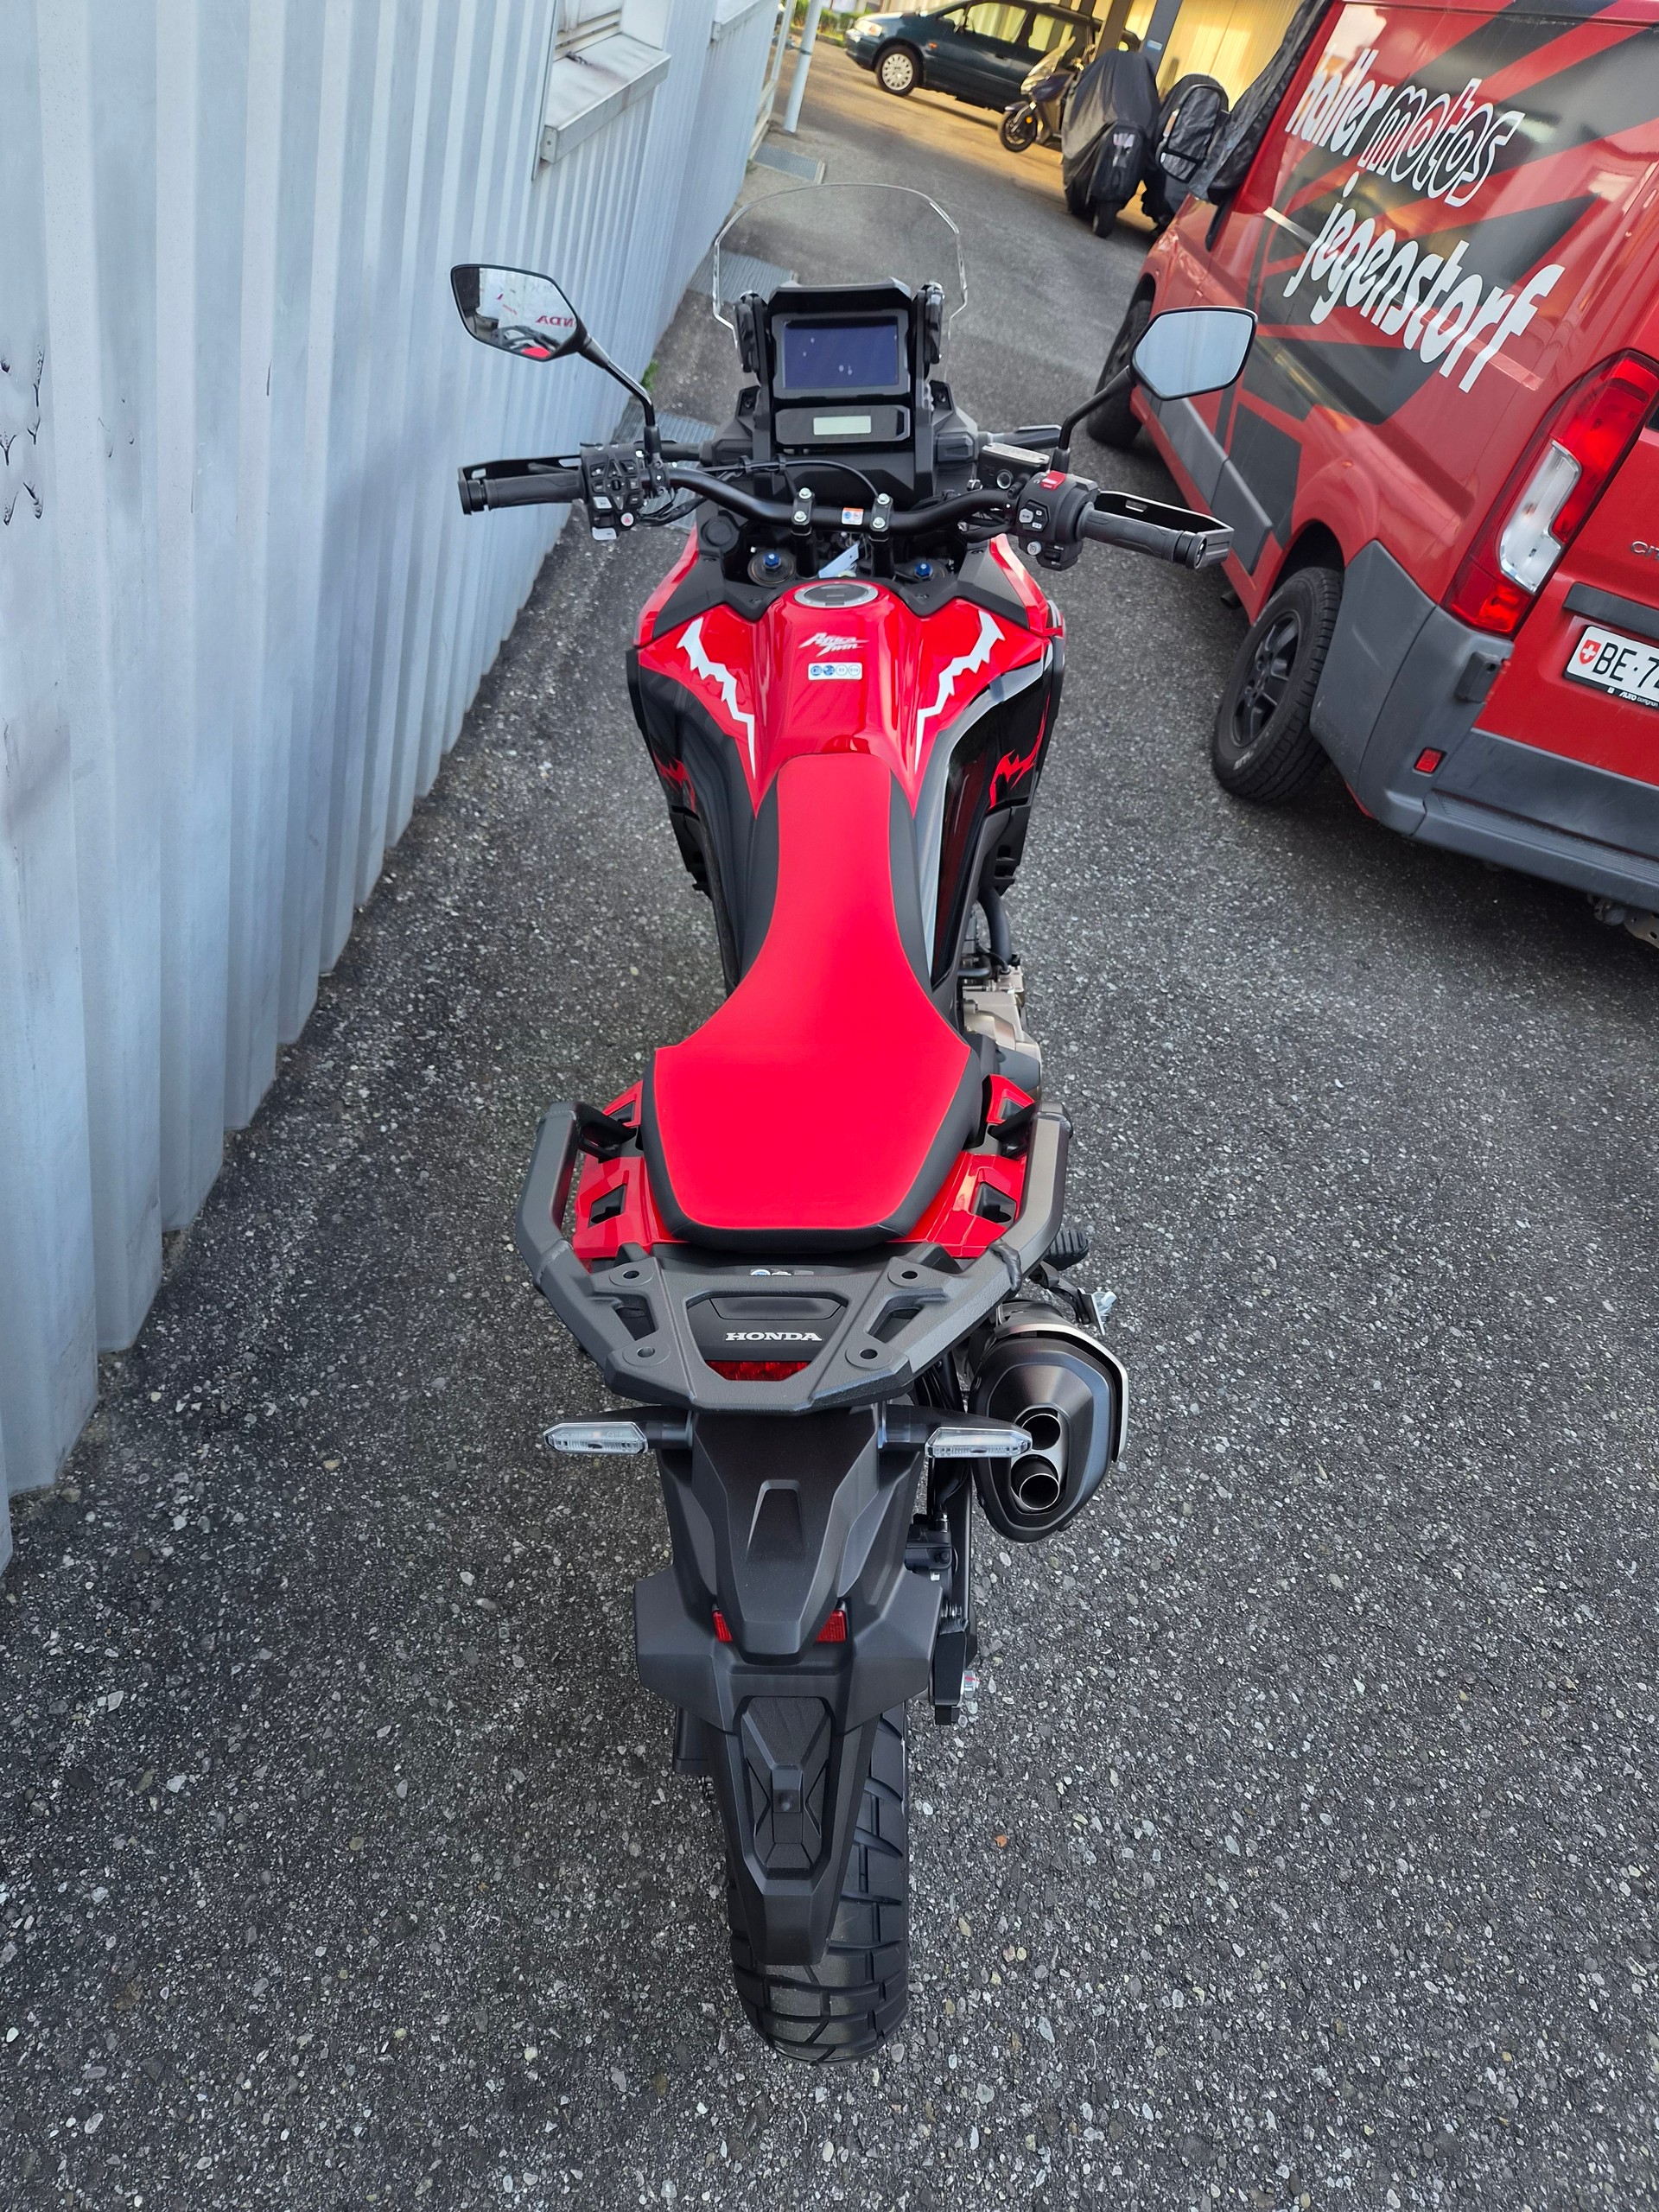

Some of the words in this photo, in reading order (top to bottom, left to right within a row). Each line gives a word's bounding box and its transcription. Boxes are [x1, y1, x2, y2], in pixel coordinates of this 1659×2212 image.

[1284, 44, 1395, 156] haller
[1357, 77, 1526, 207] motos
[1282, 170, 1567, 394] jegenstorf
[725, 1332, 823, 1341] HONDA
